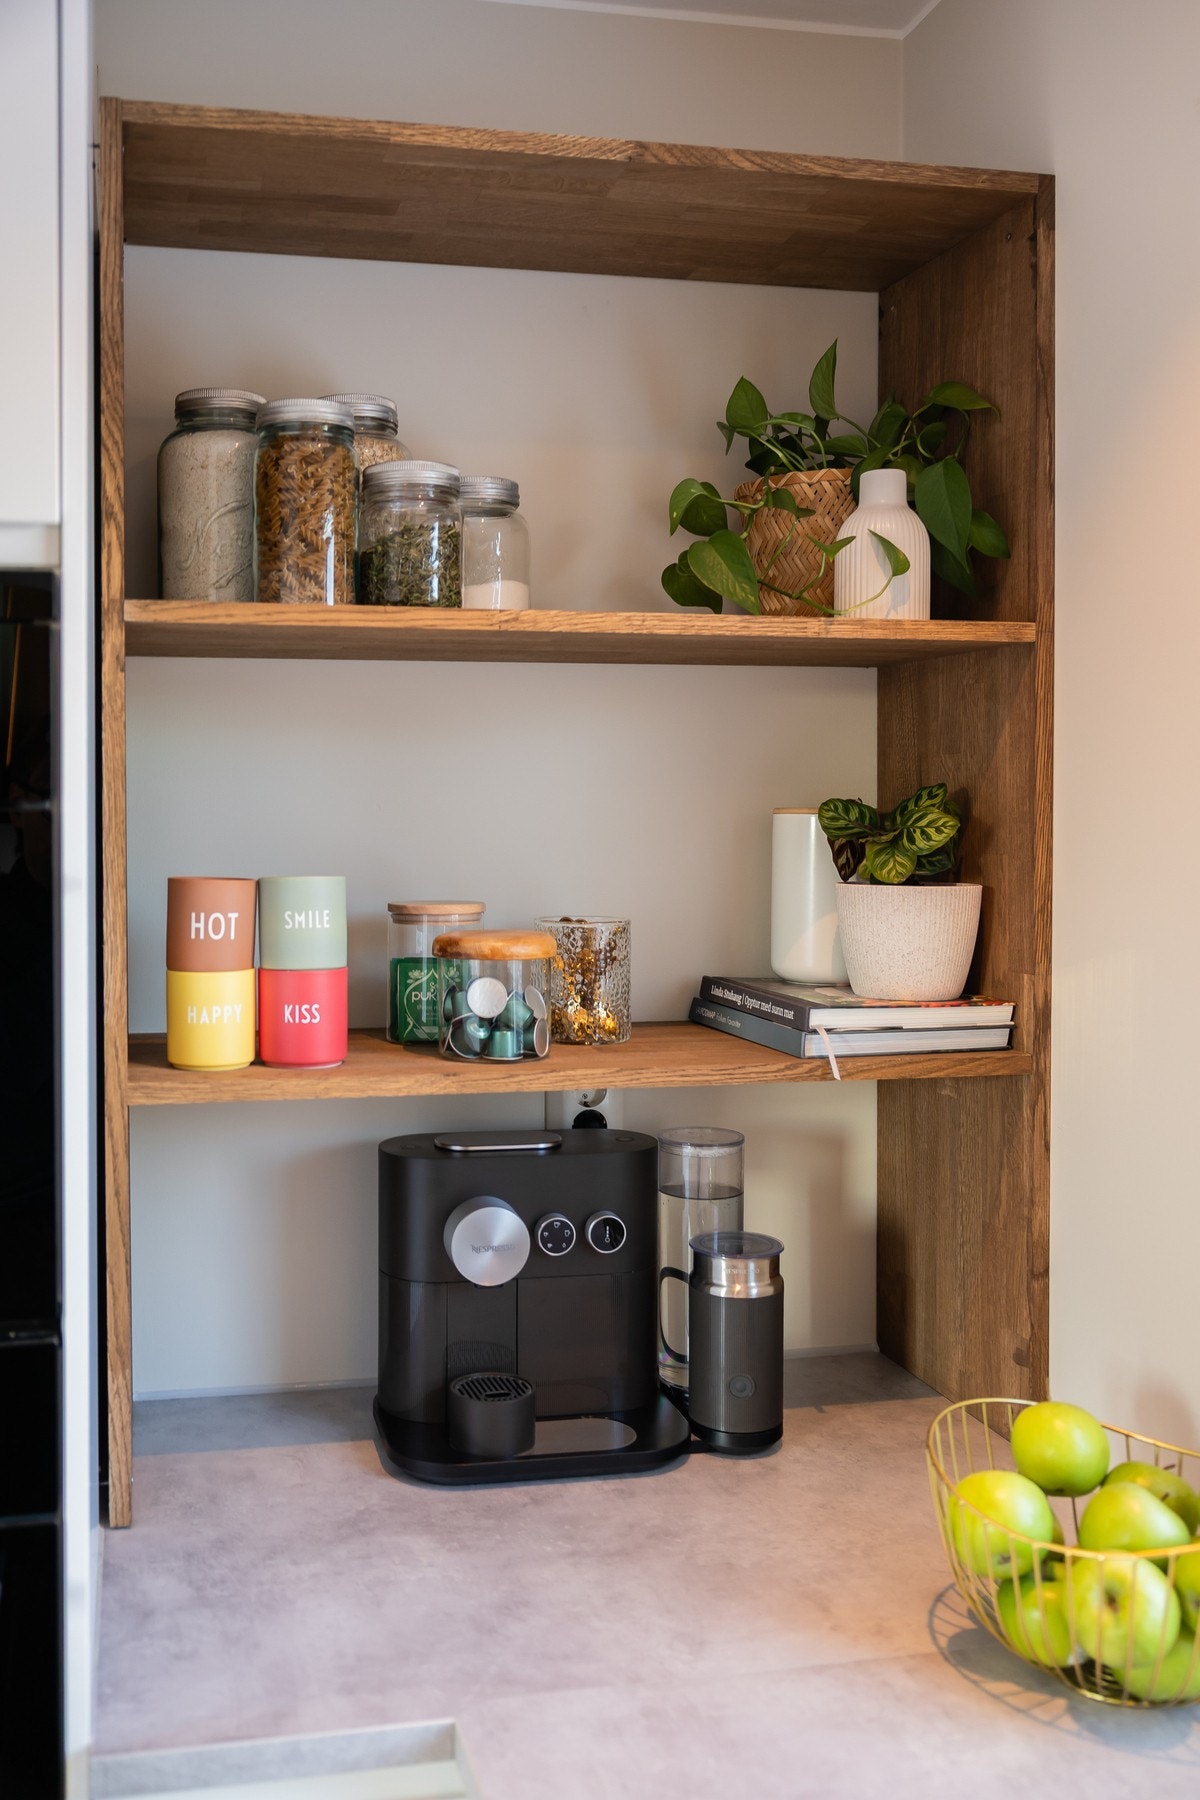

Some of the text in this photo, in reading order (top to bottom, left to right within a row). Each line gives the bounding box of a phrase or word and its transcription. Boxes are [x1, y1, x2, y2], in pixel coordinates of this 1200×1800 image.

[191, 911, 239, 940] HOT
[284, 909, 331, 929] SMILE
[412, 991, 437, 1003] puk
[711, 985, 724, 997] Linda
[745, 996, 760, 1009] Opptur
[761, 1001, 772, 1013] med
[772, 1006, 784, 1016] sunn
[784, 1010, 794, 1020] mat
[187, 1004, 242, 1024] HAPPY
[284, 1003, 320, 1024] KISS
